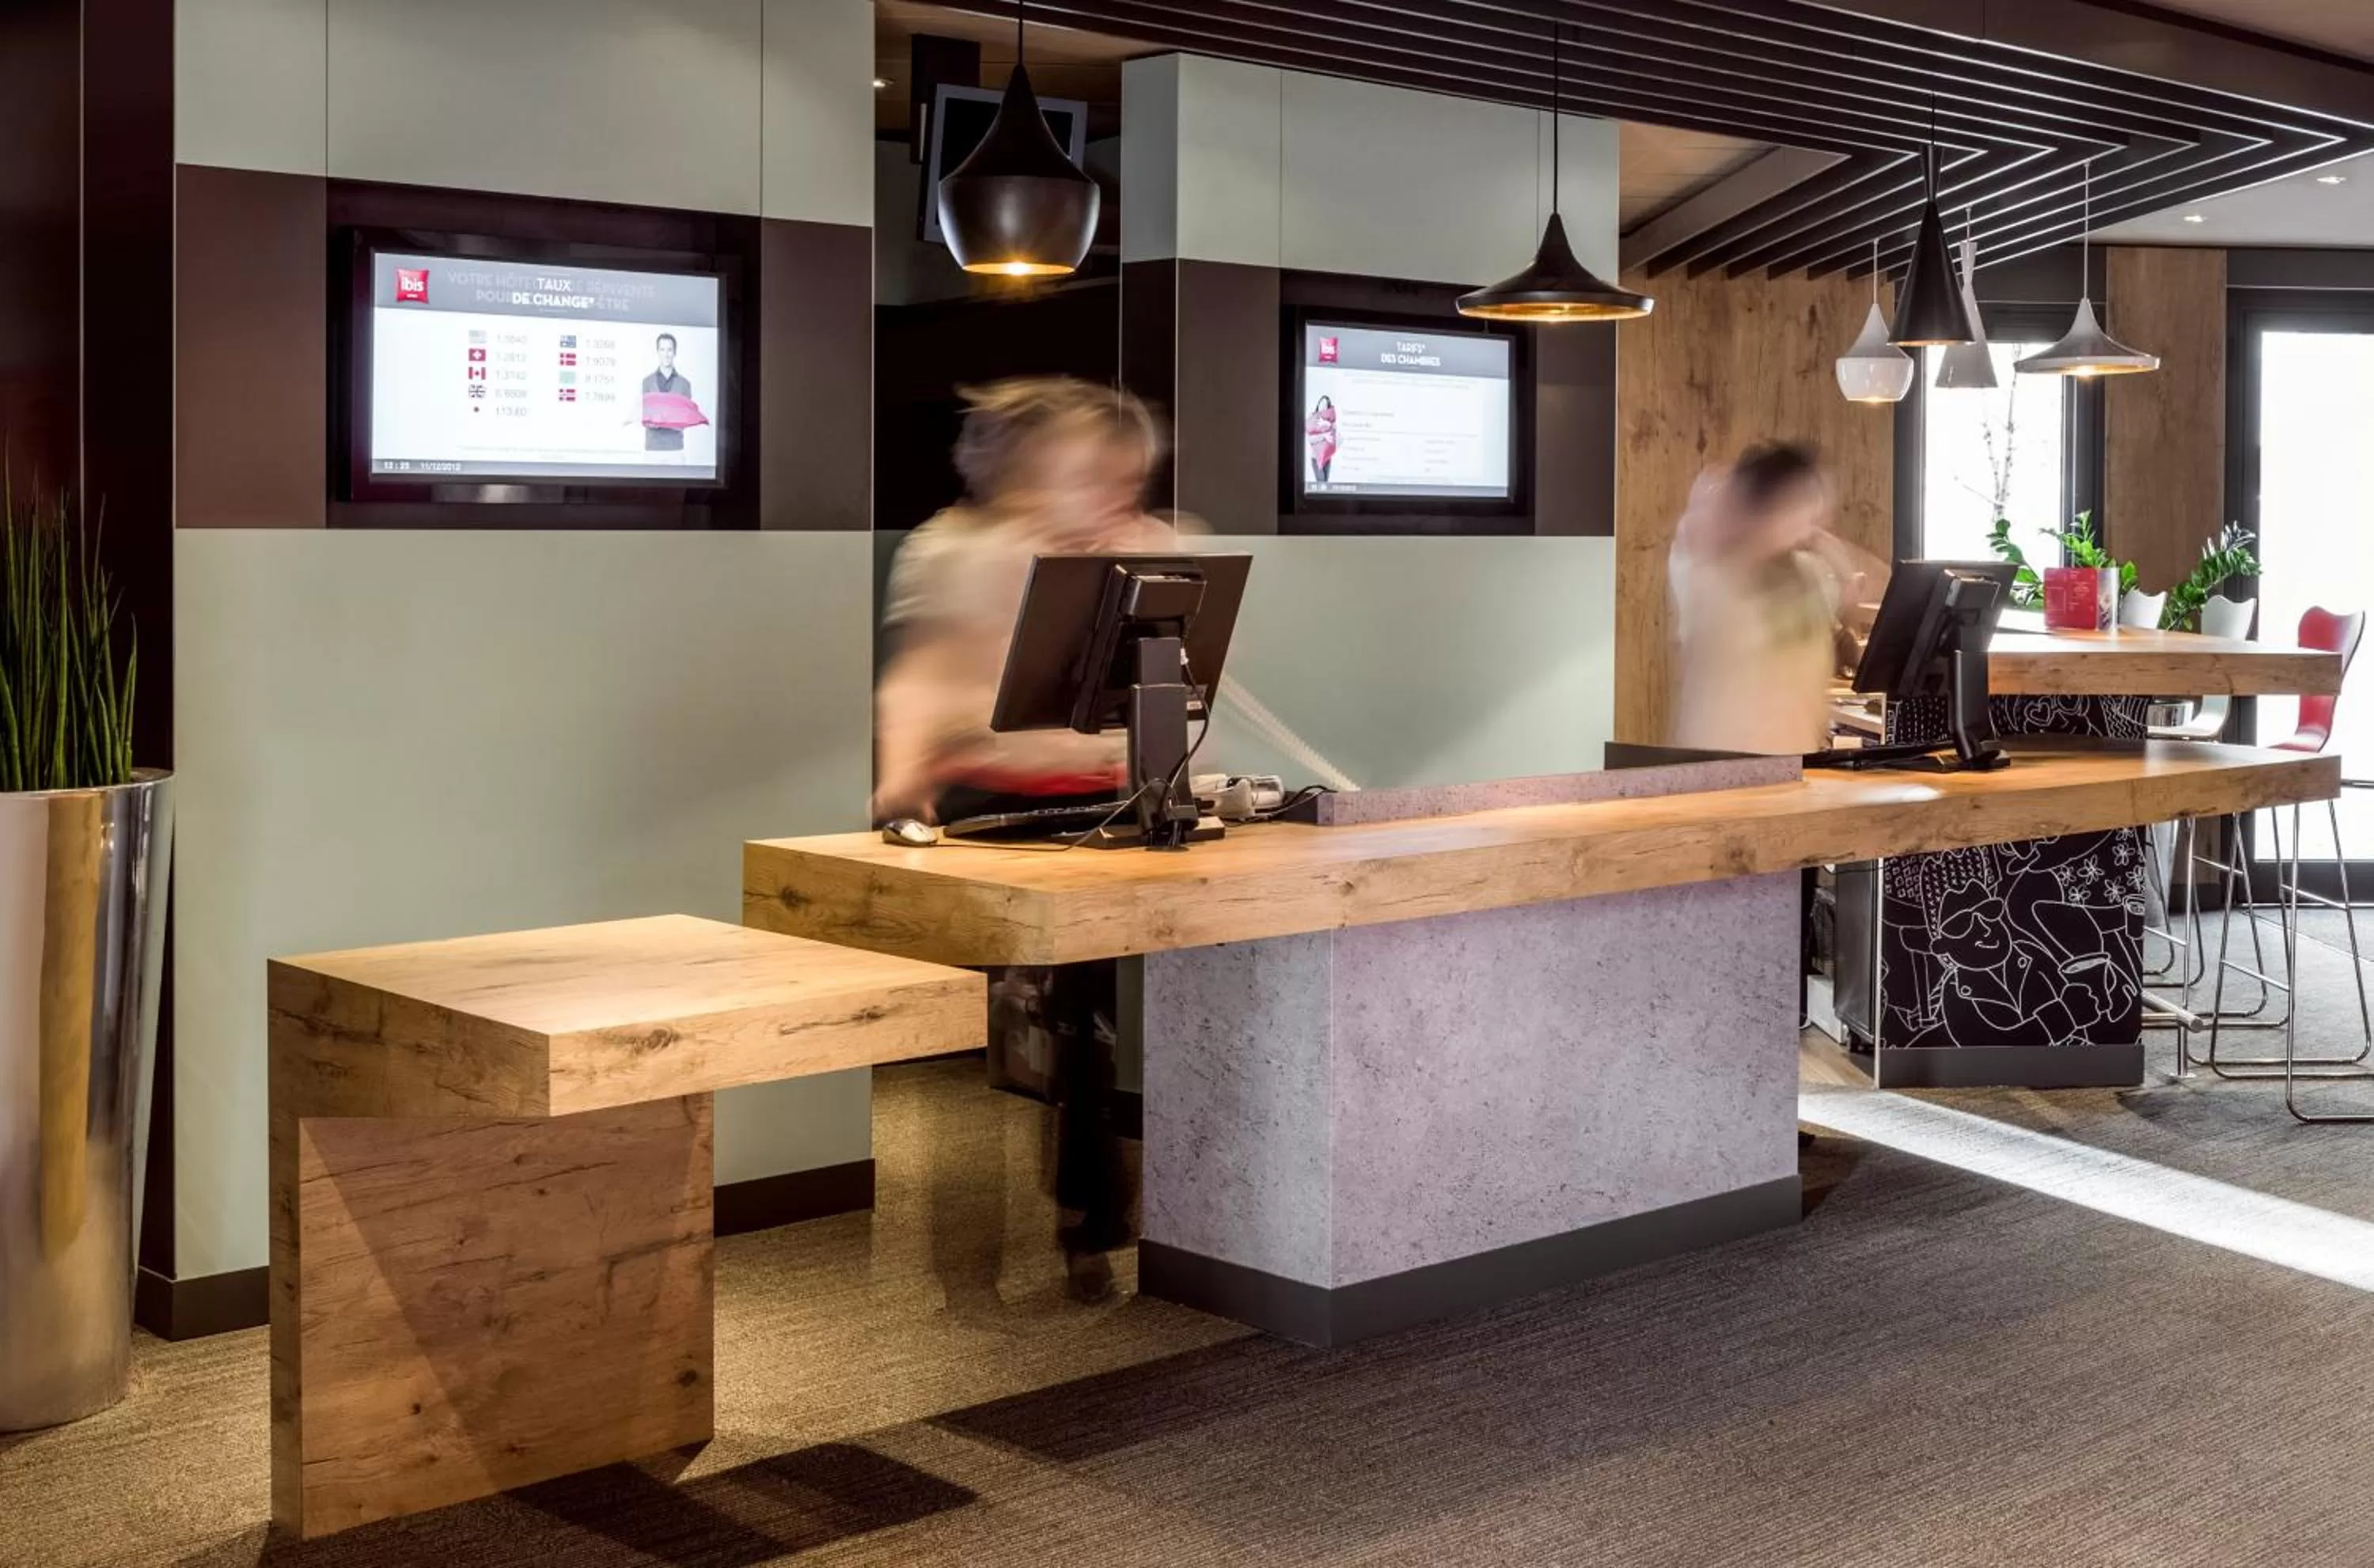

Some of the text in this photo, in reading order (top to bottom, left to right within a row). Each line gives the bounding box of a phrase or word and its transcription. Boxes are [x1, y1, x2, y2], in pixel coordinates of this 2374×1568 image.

[400, 277, 425, 292] ibis
[537, 278, 571, 292] TAUX
[512, 292, 529, 305] DE
